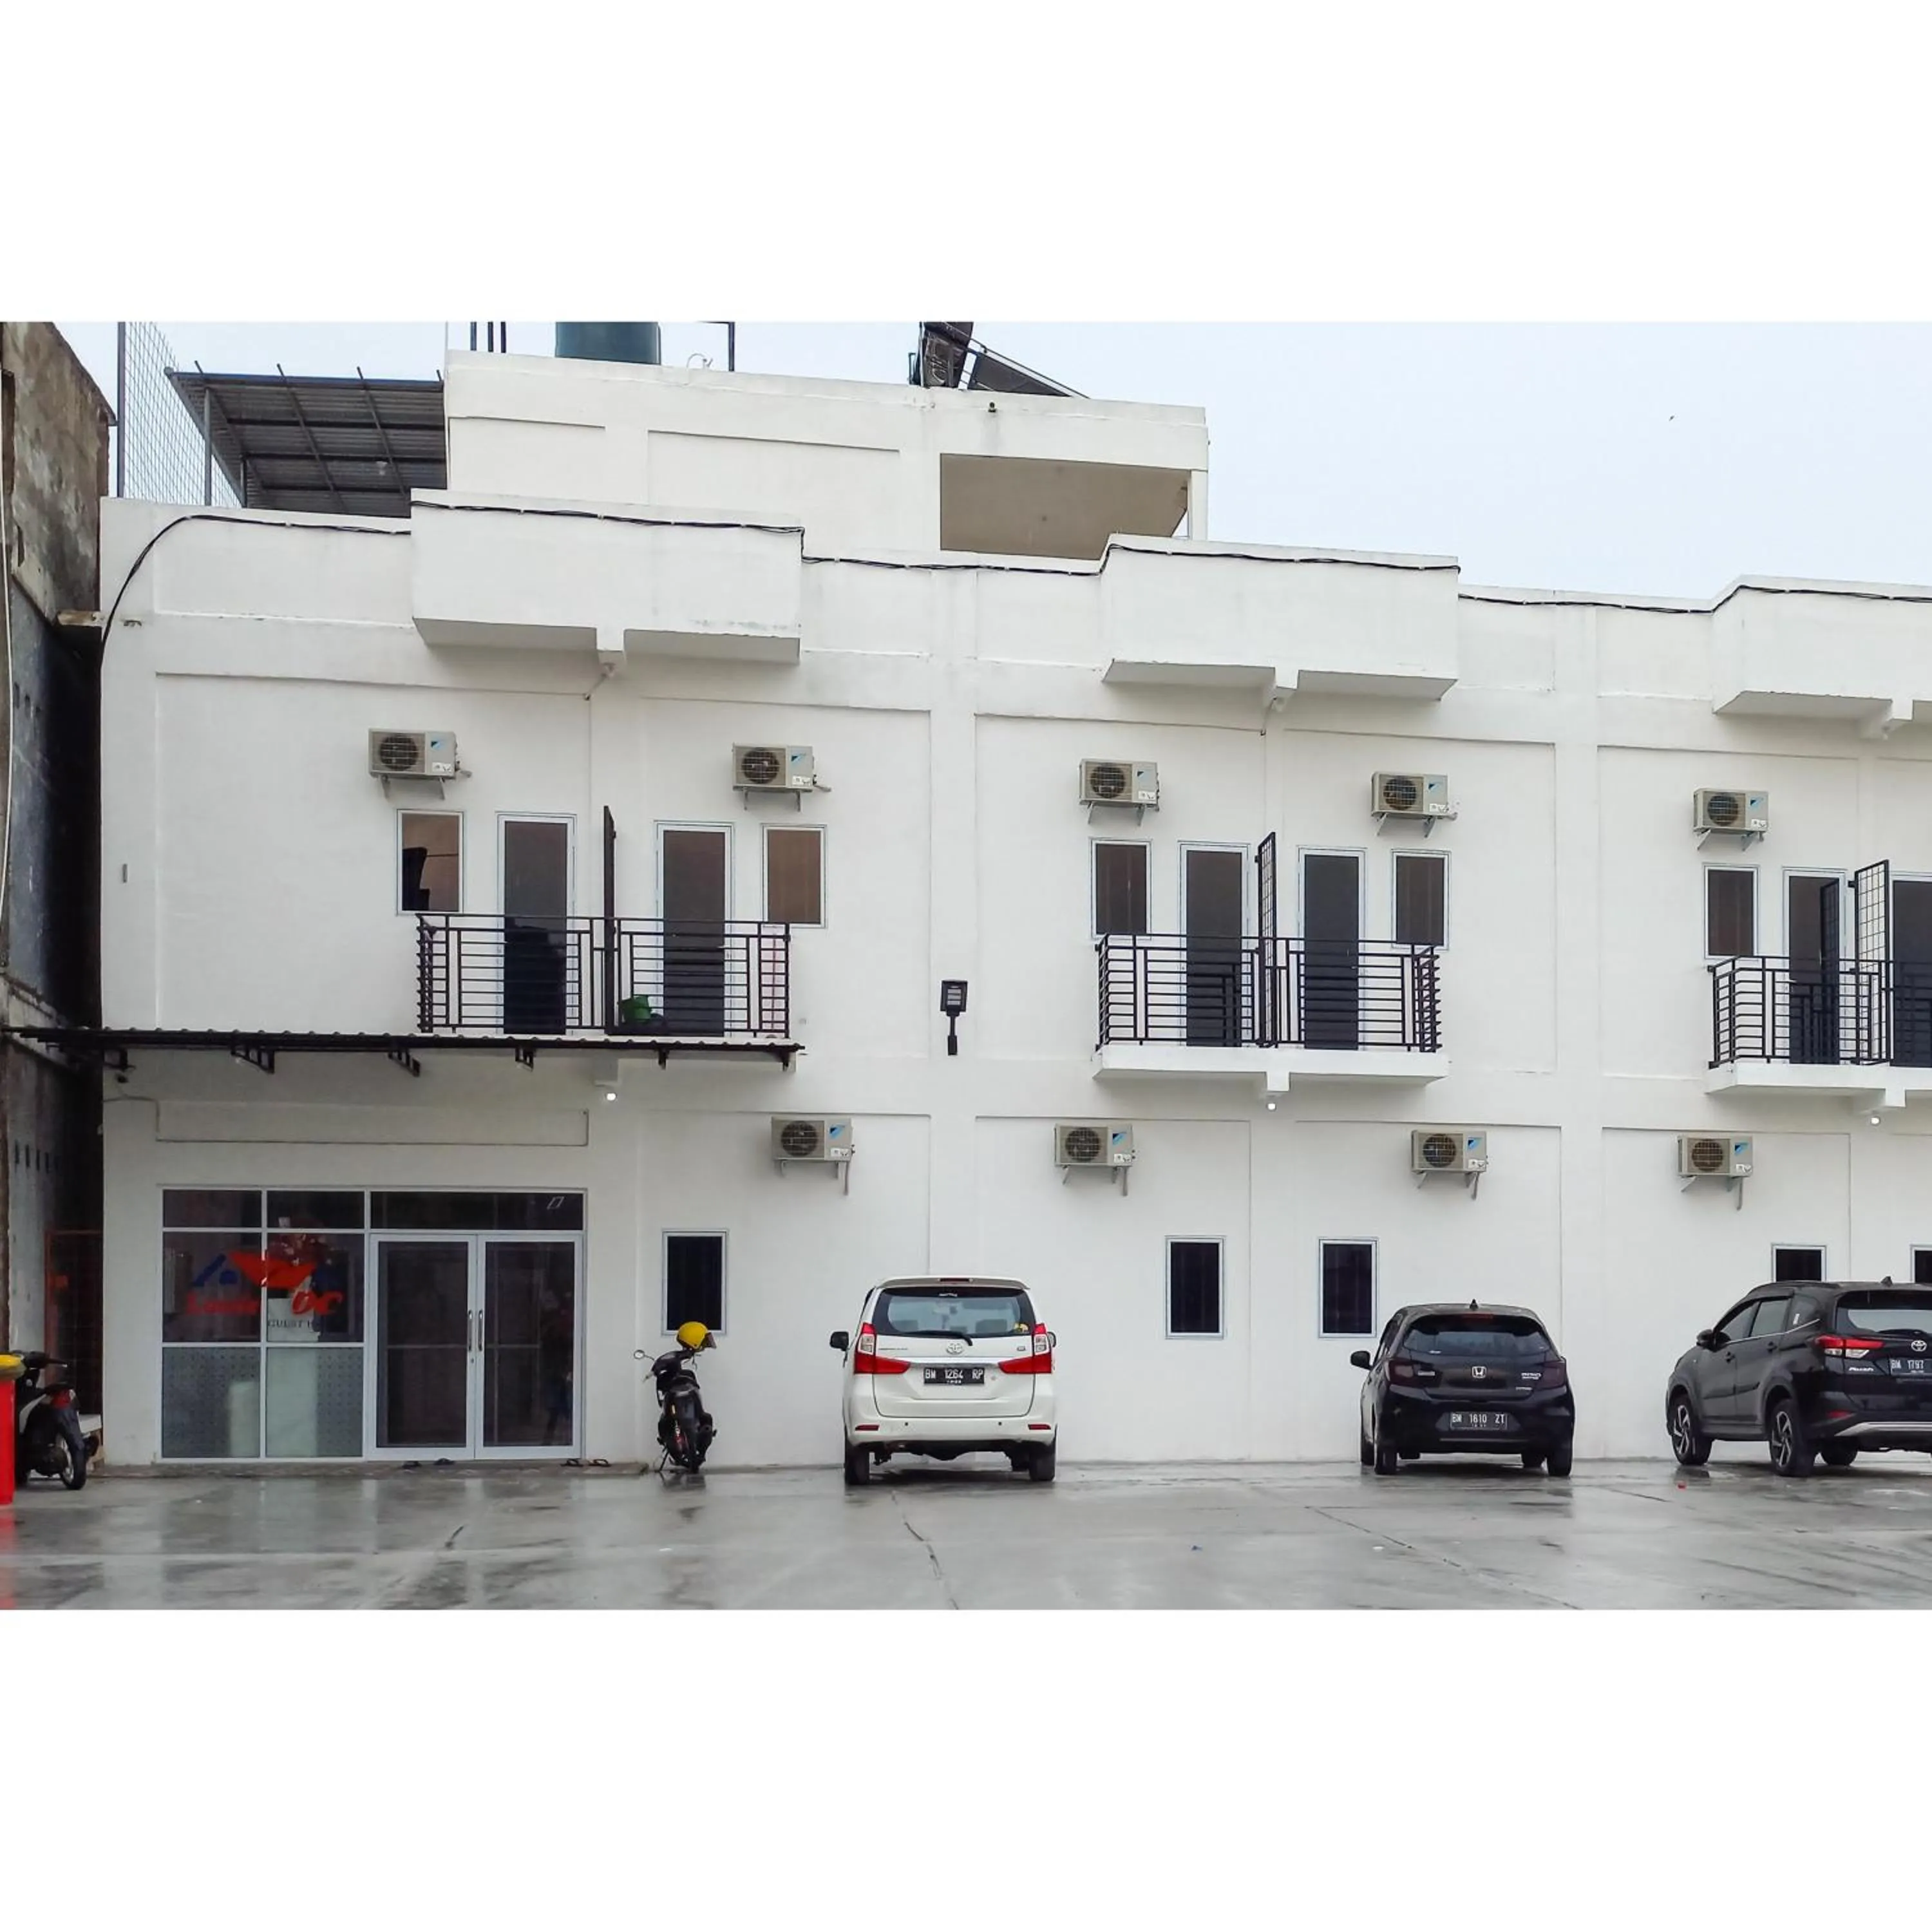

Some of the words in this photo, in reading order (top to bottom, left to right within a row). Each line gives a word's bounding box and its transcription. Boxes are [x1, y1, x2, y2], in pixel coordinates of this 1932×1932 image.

[925, 1368, 936, 1379] BM
[945, 1368, 964, 1379] 1264
[972, 1368, 983, 1379] RP
[1495, 1414, 1505, 1424] ZT
